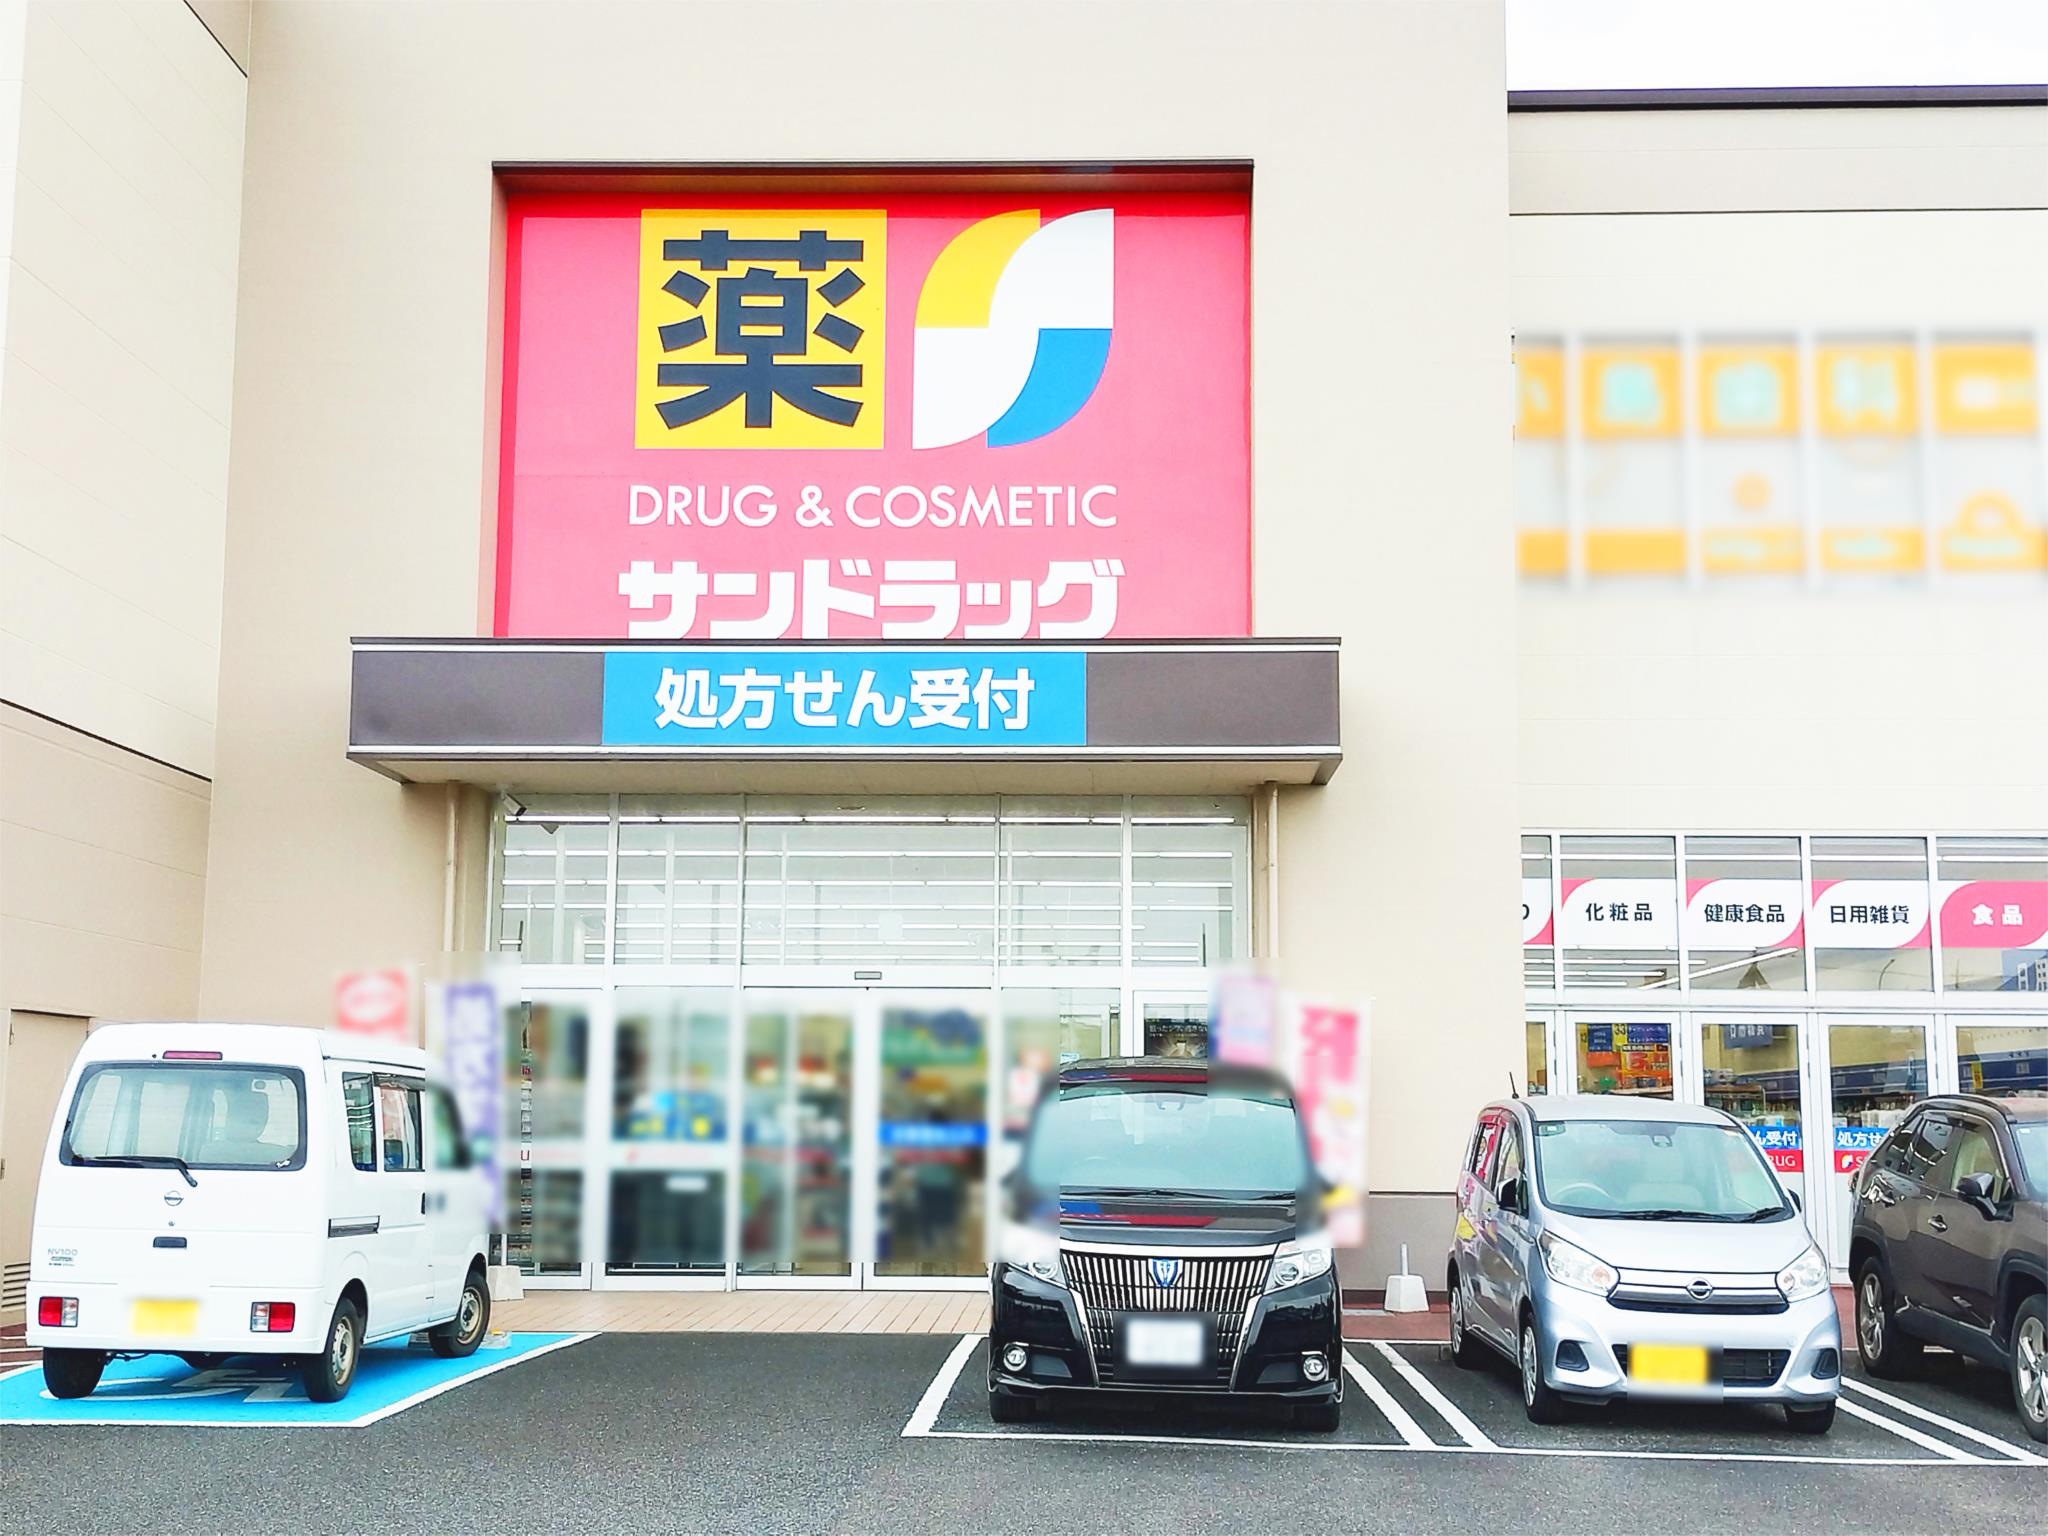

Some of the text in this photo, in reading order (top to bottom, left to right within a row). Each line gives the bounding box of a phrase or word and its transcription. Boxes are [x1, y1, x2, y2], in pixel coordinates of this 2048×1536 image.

[655, 230, 865, 430] 薬
[628, 485, 1118, 527] DRUG & COSMETIC
[618, 559, 1126, 639] サンドラッグ
[654, 667, 1035, 730] 処方せん受付
[1585, 902, 1653, 922] 化粧品
[1703, 903, 1785, 924] 健康食品
[1829, 904, 1910, 924] 日用雑貨
[1971, 904, 2024, 926] 食品
